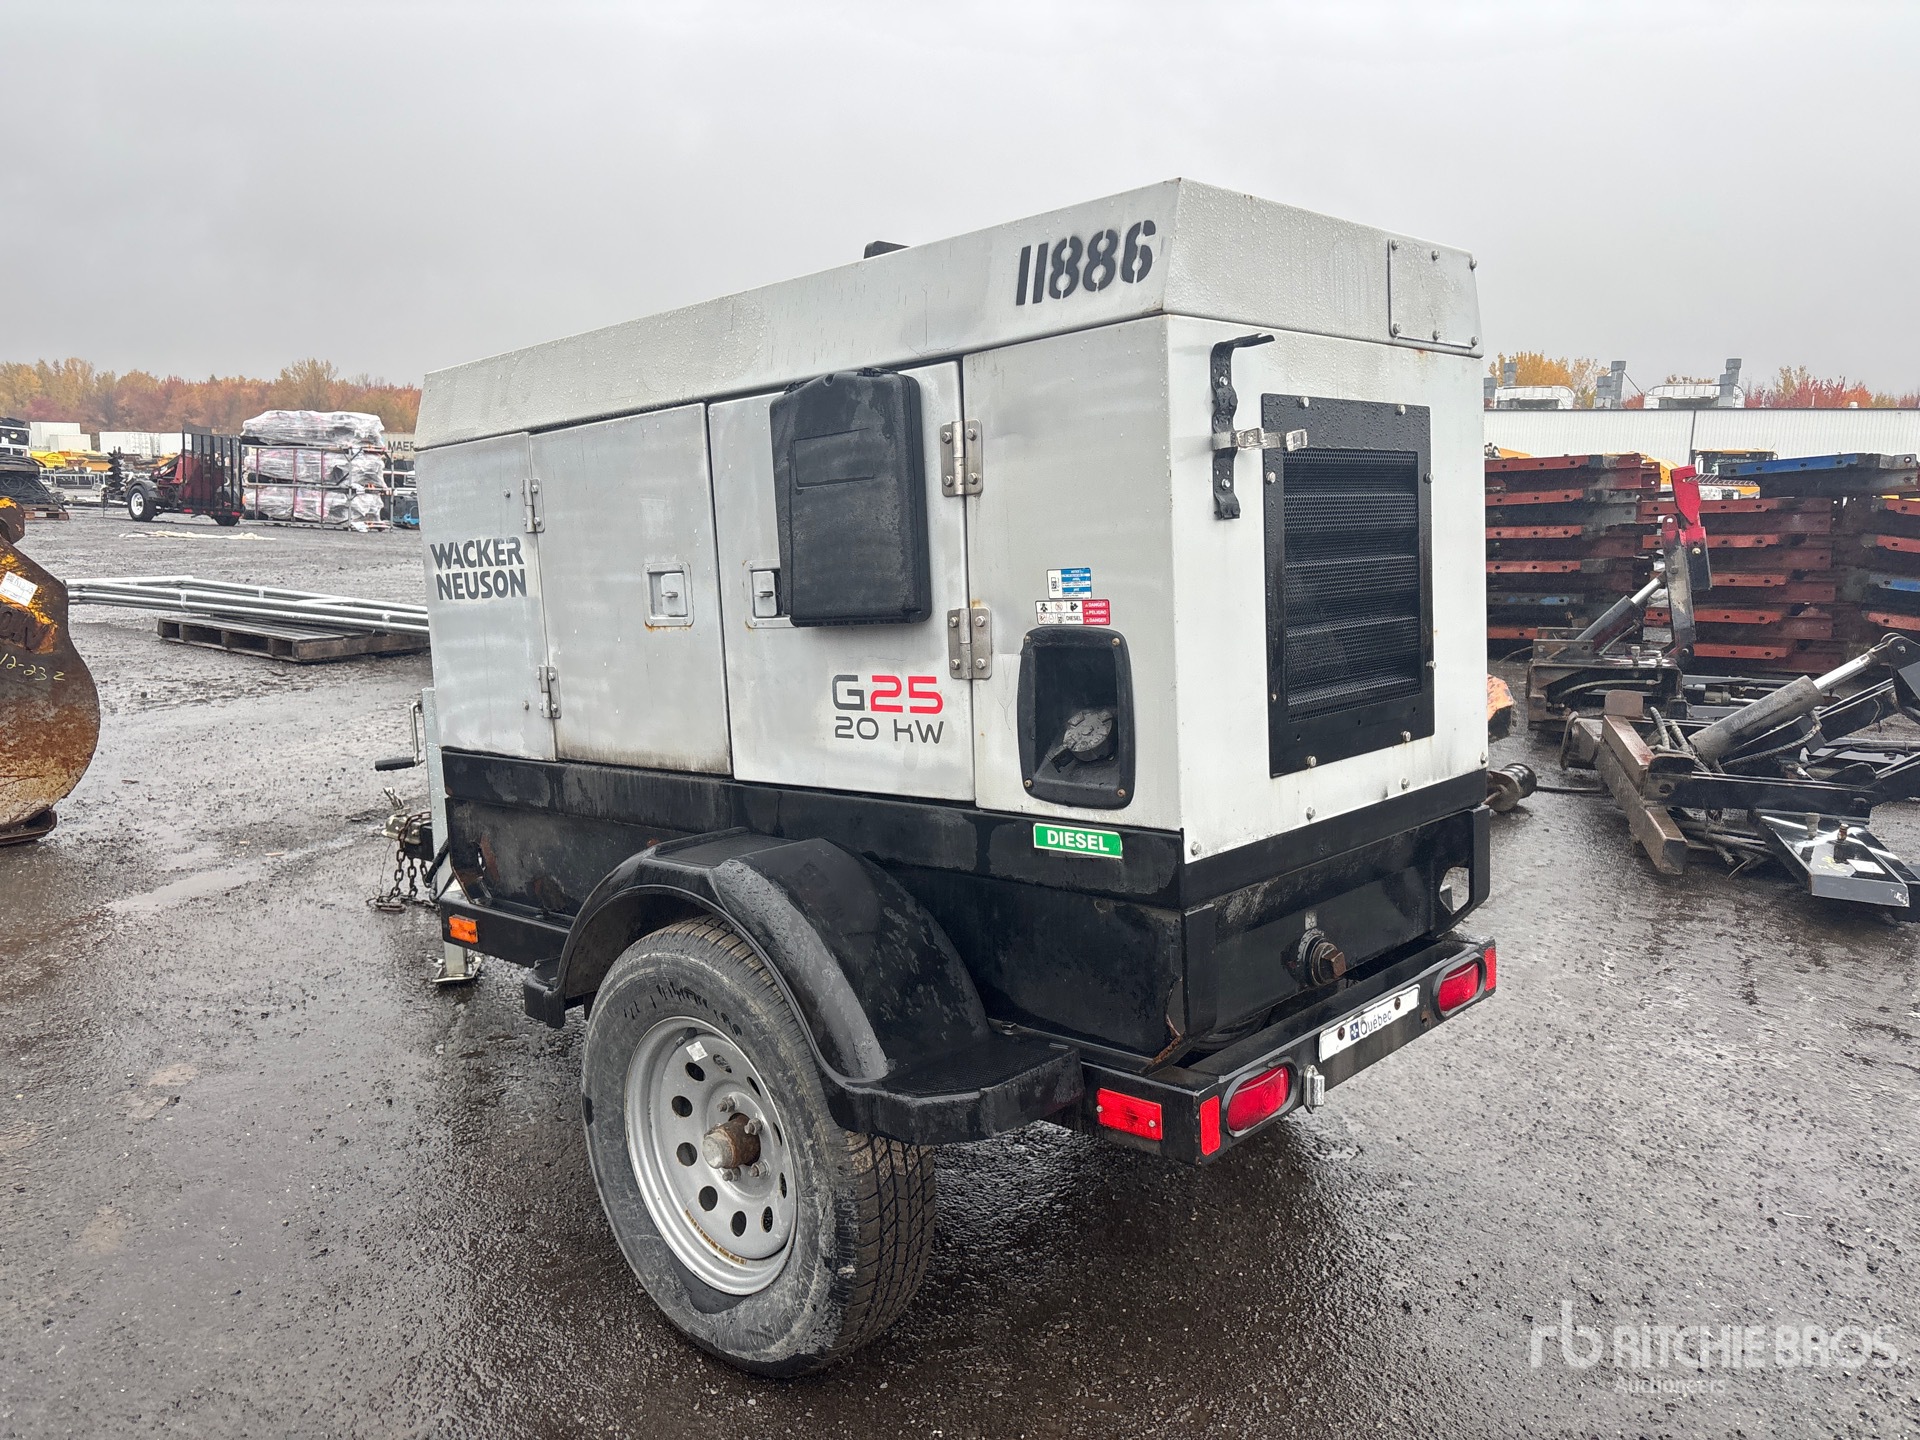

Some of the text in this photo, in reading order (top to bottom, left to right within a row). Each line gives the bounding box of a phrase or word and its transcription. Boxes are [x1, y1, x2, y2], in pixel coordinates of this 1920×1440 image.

[1016, 219, 1156, 306] 11886
[429, 537, 524, 570] WACKER
[436, 568, 527, 600] NEUSON
[832, 675, 944, 714] G25
[835, 716, 879, 740] 20
[1046, 829, 1109, 852] DIESEL
[1360, 1011, 1393, 1035] Québec
